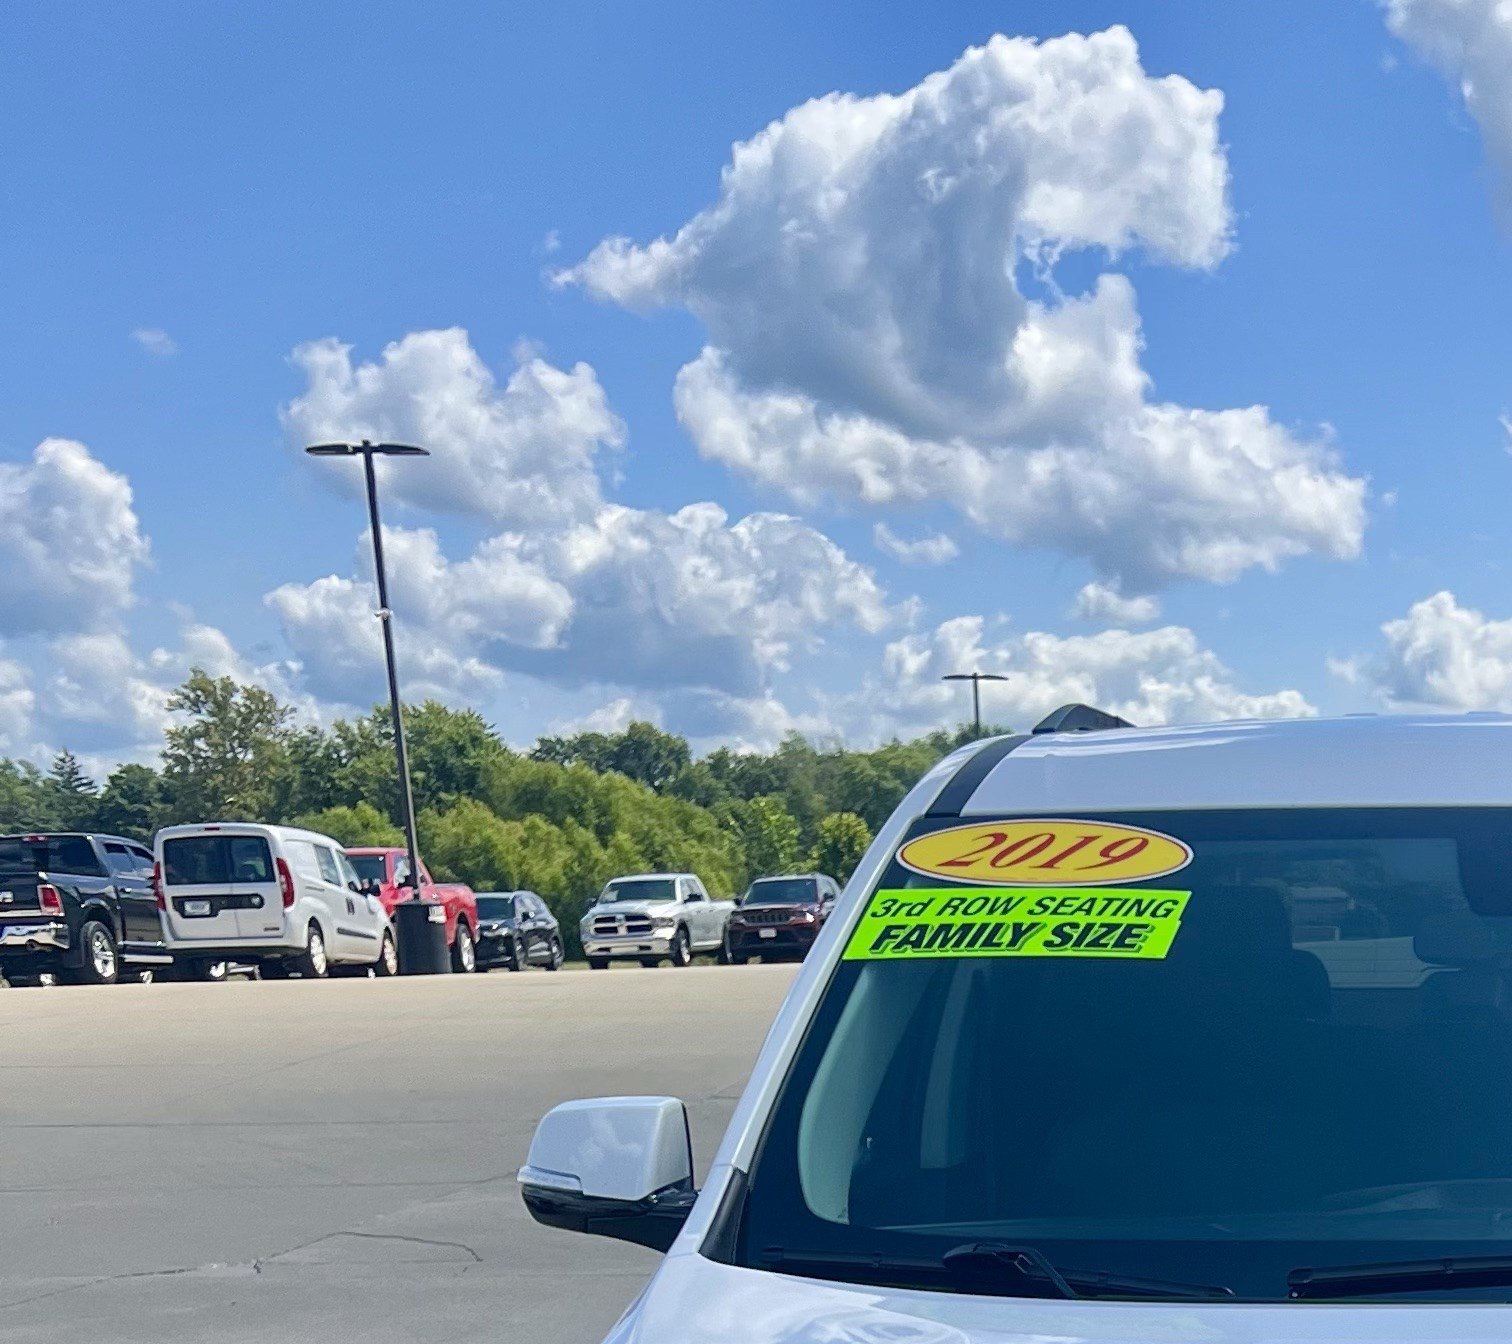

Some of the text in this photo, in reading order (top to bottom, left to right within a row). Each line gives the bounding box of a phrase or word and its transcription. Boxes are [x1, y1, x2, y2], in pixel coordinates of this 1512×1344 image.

[935, 832, 1150, 871] 2019
[870, 896, 1179, 919] 3rd ROW SEATING
[869, 921, 1154, 953] FAMILY SIZE
